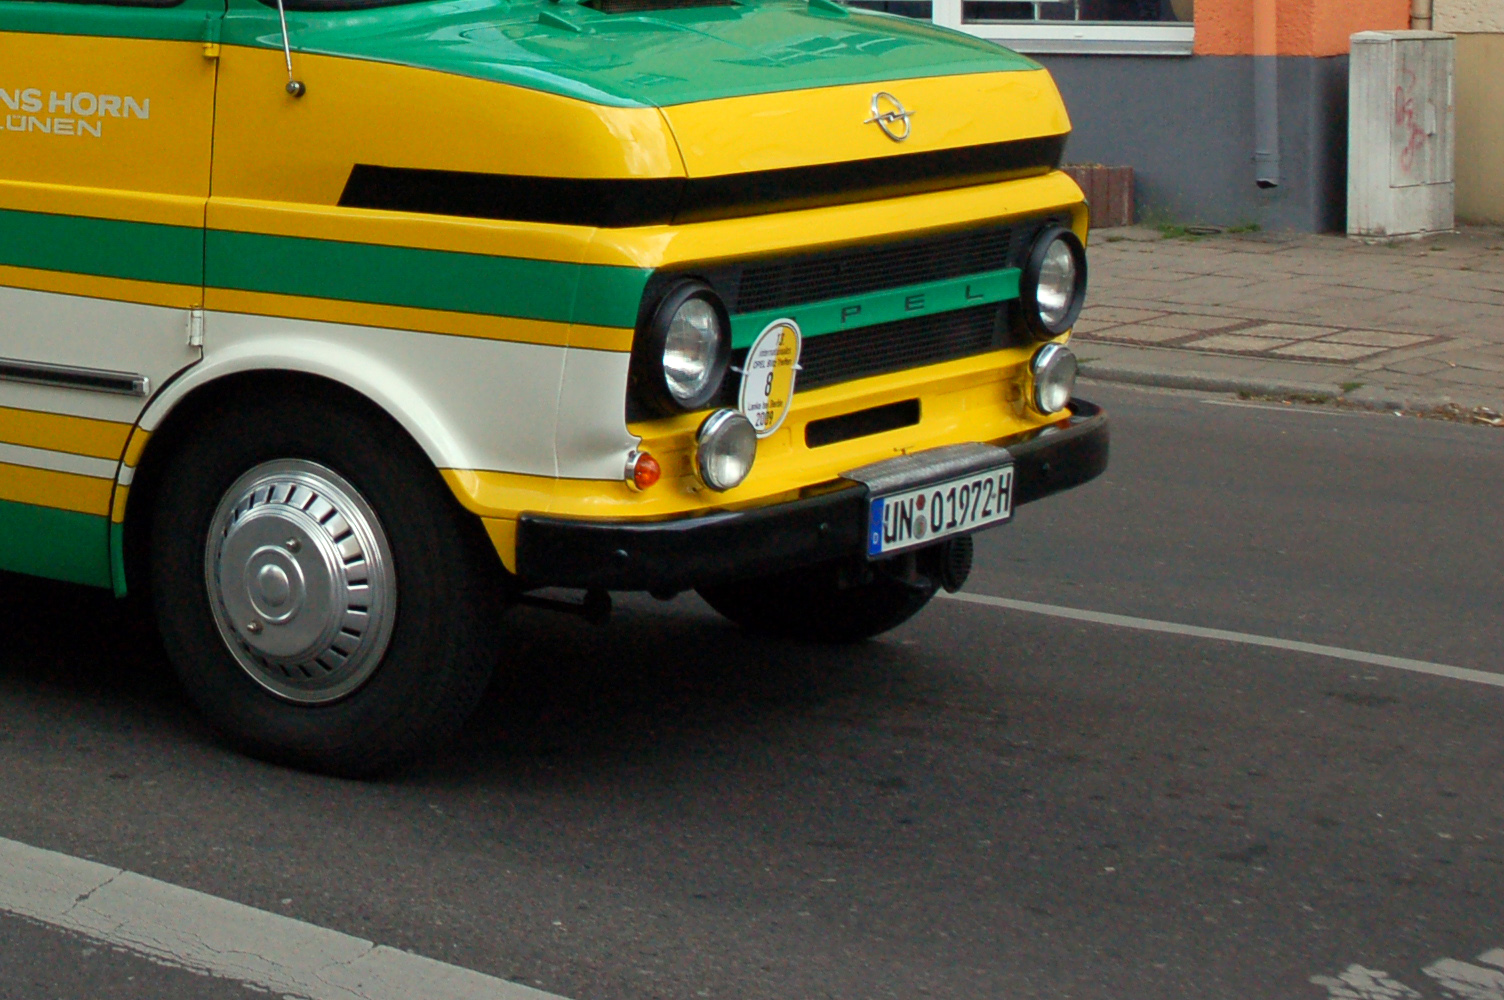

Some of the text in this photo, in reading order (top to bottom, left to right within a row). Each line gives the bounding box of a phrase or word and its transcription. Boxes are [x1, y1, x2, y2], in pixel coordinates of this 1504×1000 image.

[48, 91, 150, 119] HORN
[841, 285, 984, 324] PEL
[764, 371, 774, 397] 8
[883, 498, 914, 543] UN
